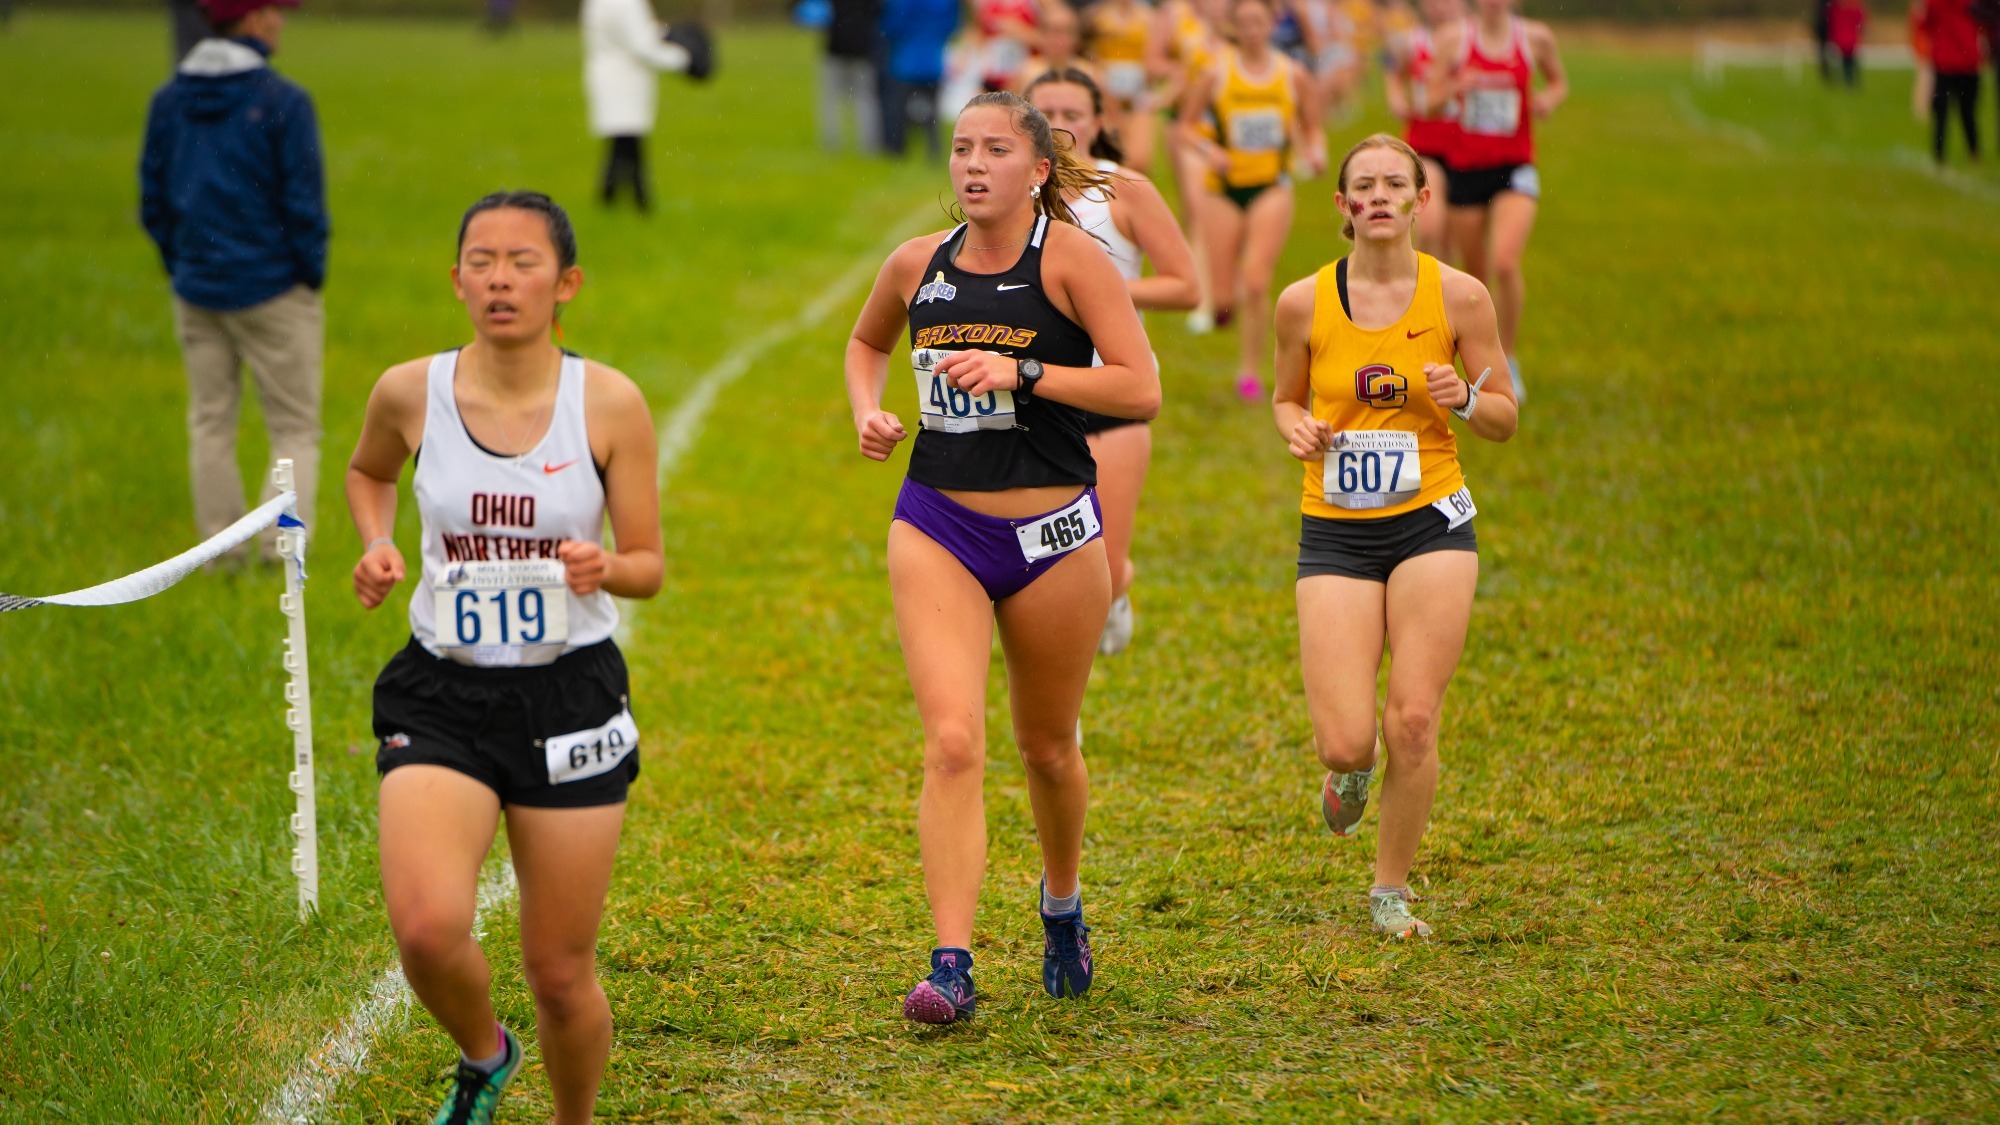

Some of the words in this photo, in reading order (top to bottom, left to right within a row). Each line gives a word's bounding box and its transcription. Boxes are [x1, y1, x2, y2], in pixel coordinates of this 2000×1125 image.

[916, 324, 1037, 349] SAXONS
[1351, 441, 1415, 449] INVITATIONAL
[1338, 451, 1404, 493] 607
[472, 493, 535, 528] OHIO
[1041, 508, 1086, 551] 465
[455, 588, 545, 645] 619
[569, 728, 624, 770] 619
